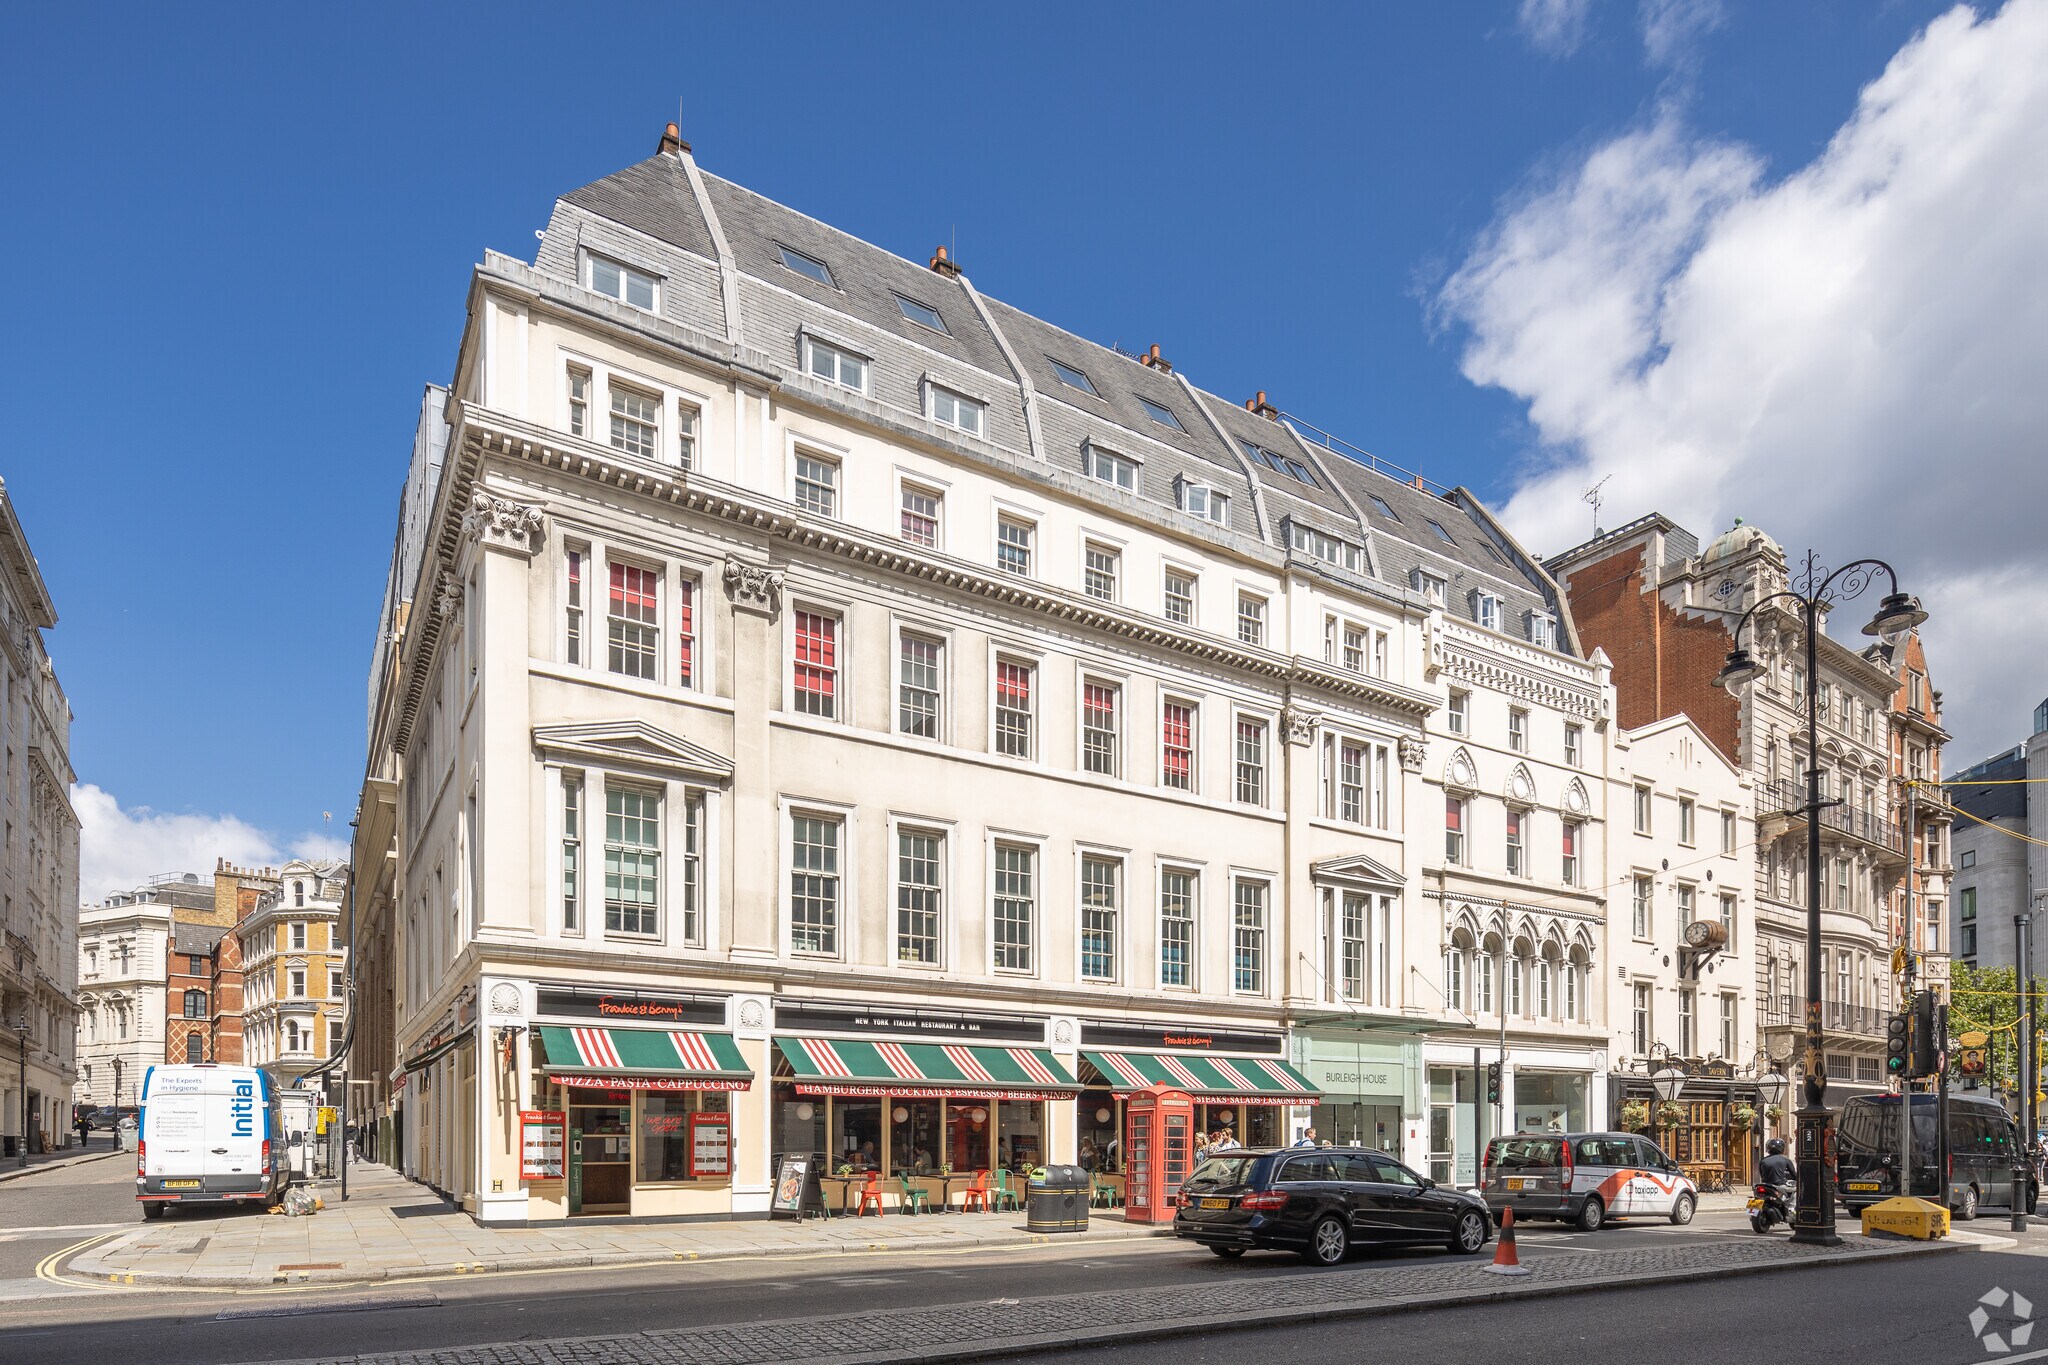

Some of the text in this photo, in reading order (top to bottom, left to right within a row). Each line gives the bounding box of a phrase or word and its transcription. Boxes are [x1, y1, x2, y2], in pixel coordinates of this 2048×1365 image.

[598, 995, 683, 1020] Frankie & Benny's
[855, 1017, 868, 1025] NEW
[872, 1018, 889, 1026] YORK
[893, 1019, 917, 1028] ITALIAN
[921, 1021, 957, 1030] RESTAURANT
[969, 1023, 980, 1031] BAR
[1163, 1030, 1187, 1046] Frankie
[1192, 1032, 1212, 1049] Benny's
[1707, 1067, 1727, 1076] TAVERN
[561, 1076, 744, 1090] PIZZA PASTA CAPPUCCINO
[1325, 1072, 1387, 1084] BURLEIGH HOUSE
[804, 1083, 1072, 1100] HAMBURGERS COCKTAILS ESPRESSO BEERS WINES
[1230, 1096, 1261, 1104] SALADS
[1263, 1097, 1296, 1105] LASAGNE
[231, 1079, 253, 1137] Initial
[646, 1115, 682, 1125] we are
[651, 1125, 678, 1135] open
[492, 1180, 503, 1191] H
[1634, 1185, 1659, 1196] taxiapp
